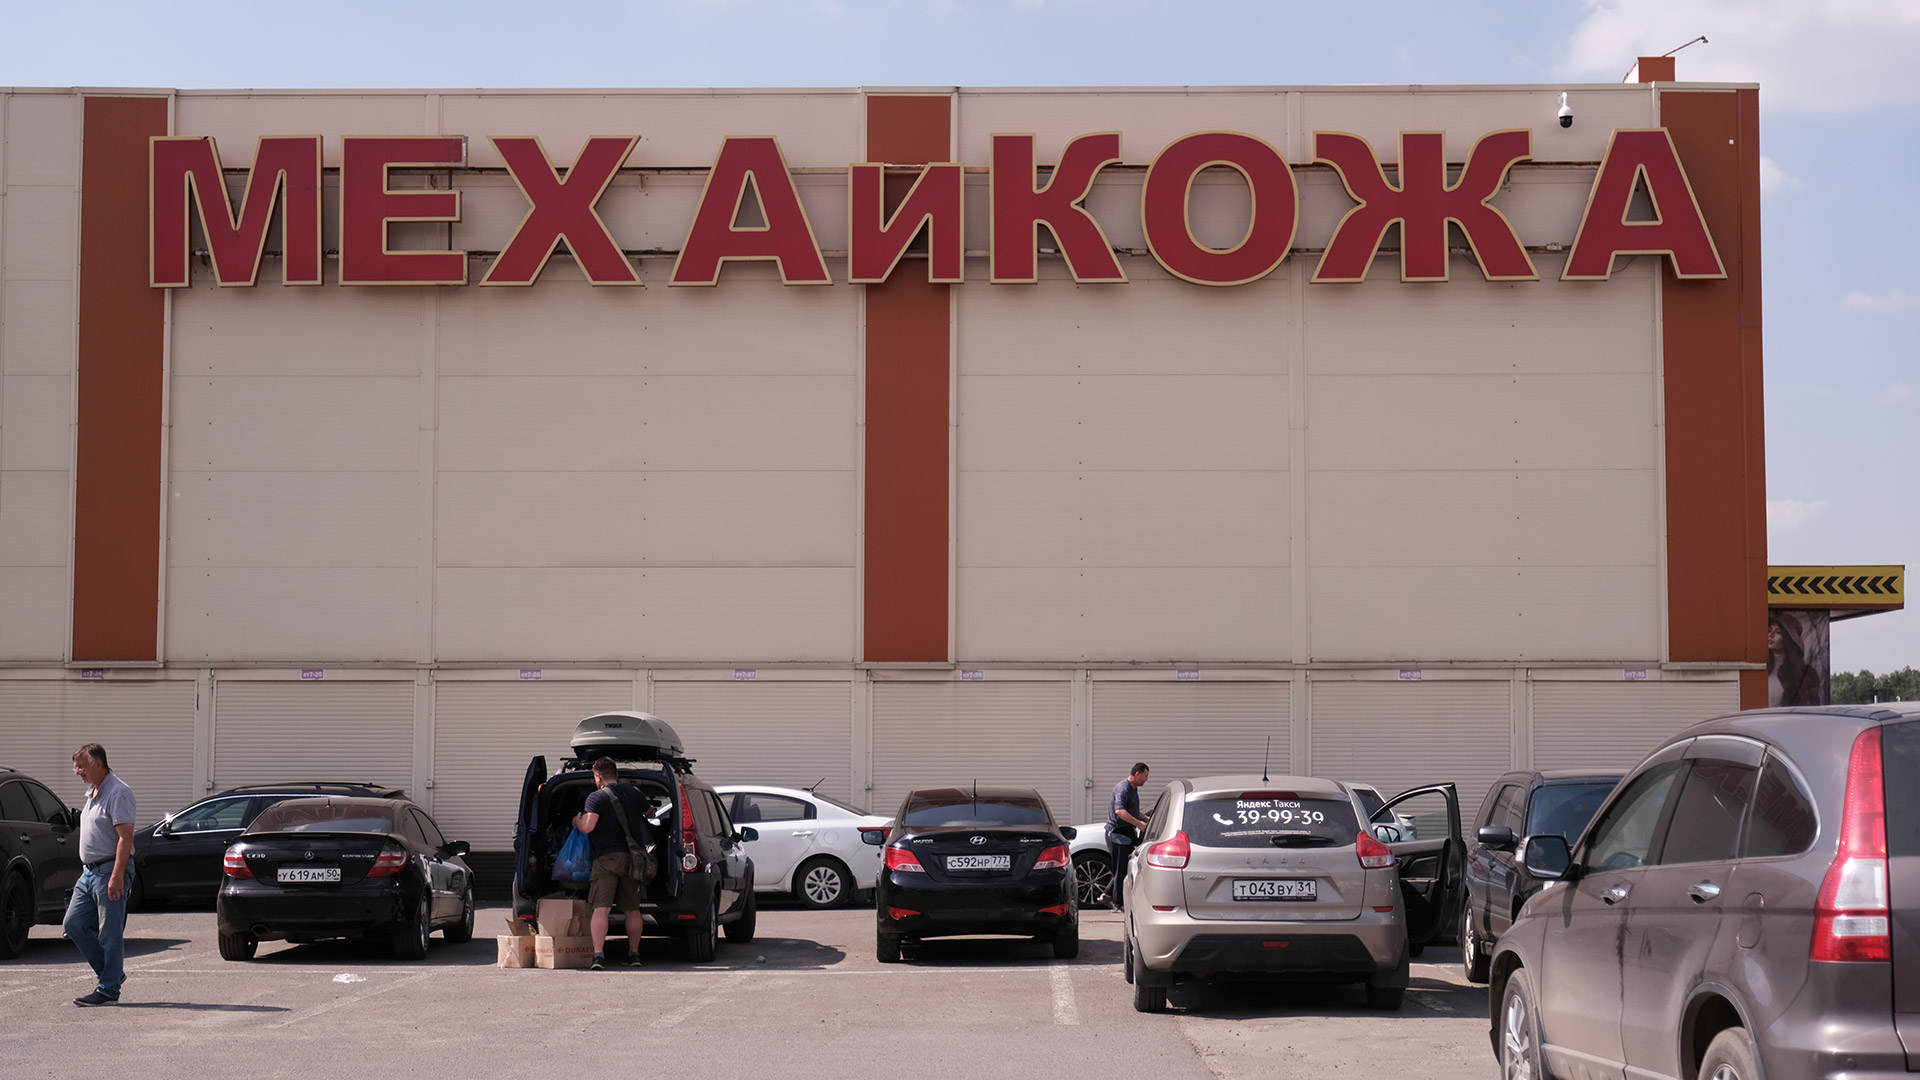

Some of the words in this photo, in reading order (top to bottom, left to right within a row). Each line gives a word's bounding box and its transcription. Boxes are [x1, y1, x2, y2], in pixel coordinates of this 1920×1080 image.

[1236, 800, 1271, 809] Яндекс
[1273, 799, 1301, 808] Такси
[1236, 809, 1324, 825] 39-99-39
[1297, 882, 1312, 892] 31
